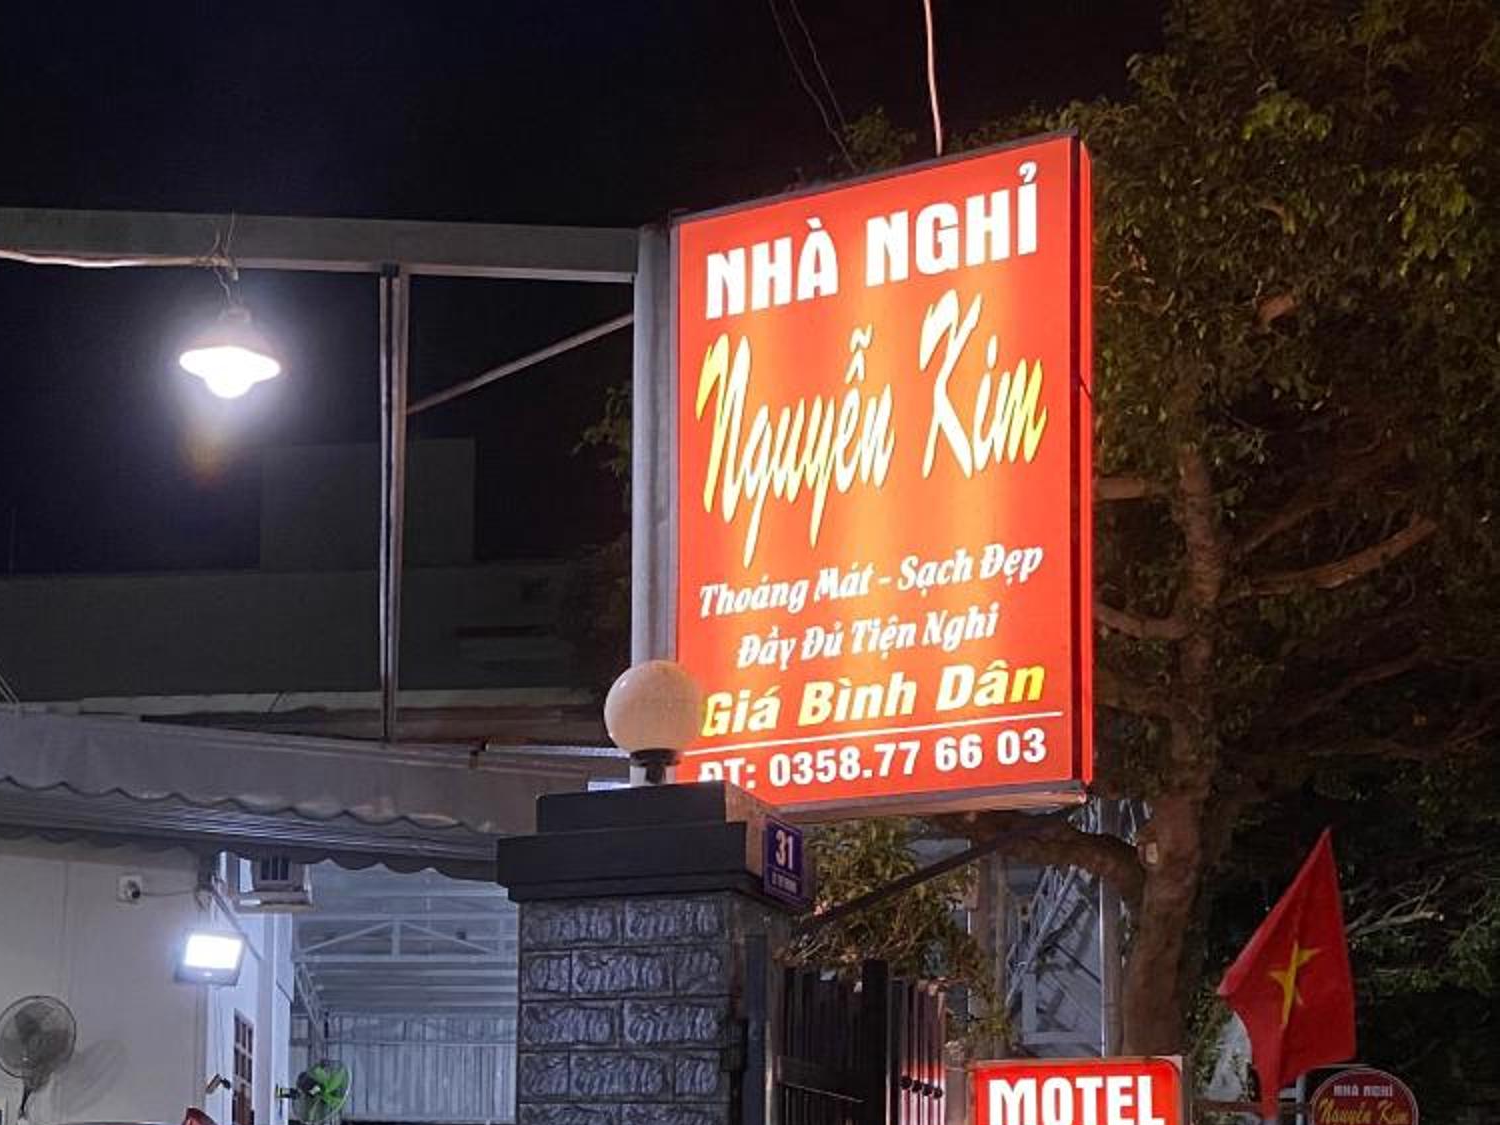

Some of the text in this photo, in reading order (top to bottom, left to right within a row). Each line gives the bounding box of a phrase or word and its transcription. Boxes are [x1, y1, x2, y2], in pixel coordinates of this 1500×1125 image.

[706, 161, 1037, 319] NHÀ NGHỈ
[696, 289, 1047, 568] Nguyễn Kim
[700, 575, 809, 618] Thoáng
[814, 561, 875, 602] Mát
[897, 549, 973, 596] Sạch
[979, 543, 1044, 586] Đẹp
[736, 602, 1000, 671] Đầy Đủ Tiện Nghi
[702, 660, 1046, 737] Giá Bình Dân
[769, 741, 920, 787] 0358.77
[934, 734, 983, 771] 66
[997, 728, 1047, 765] 03
